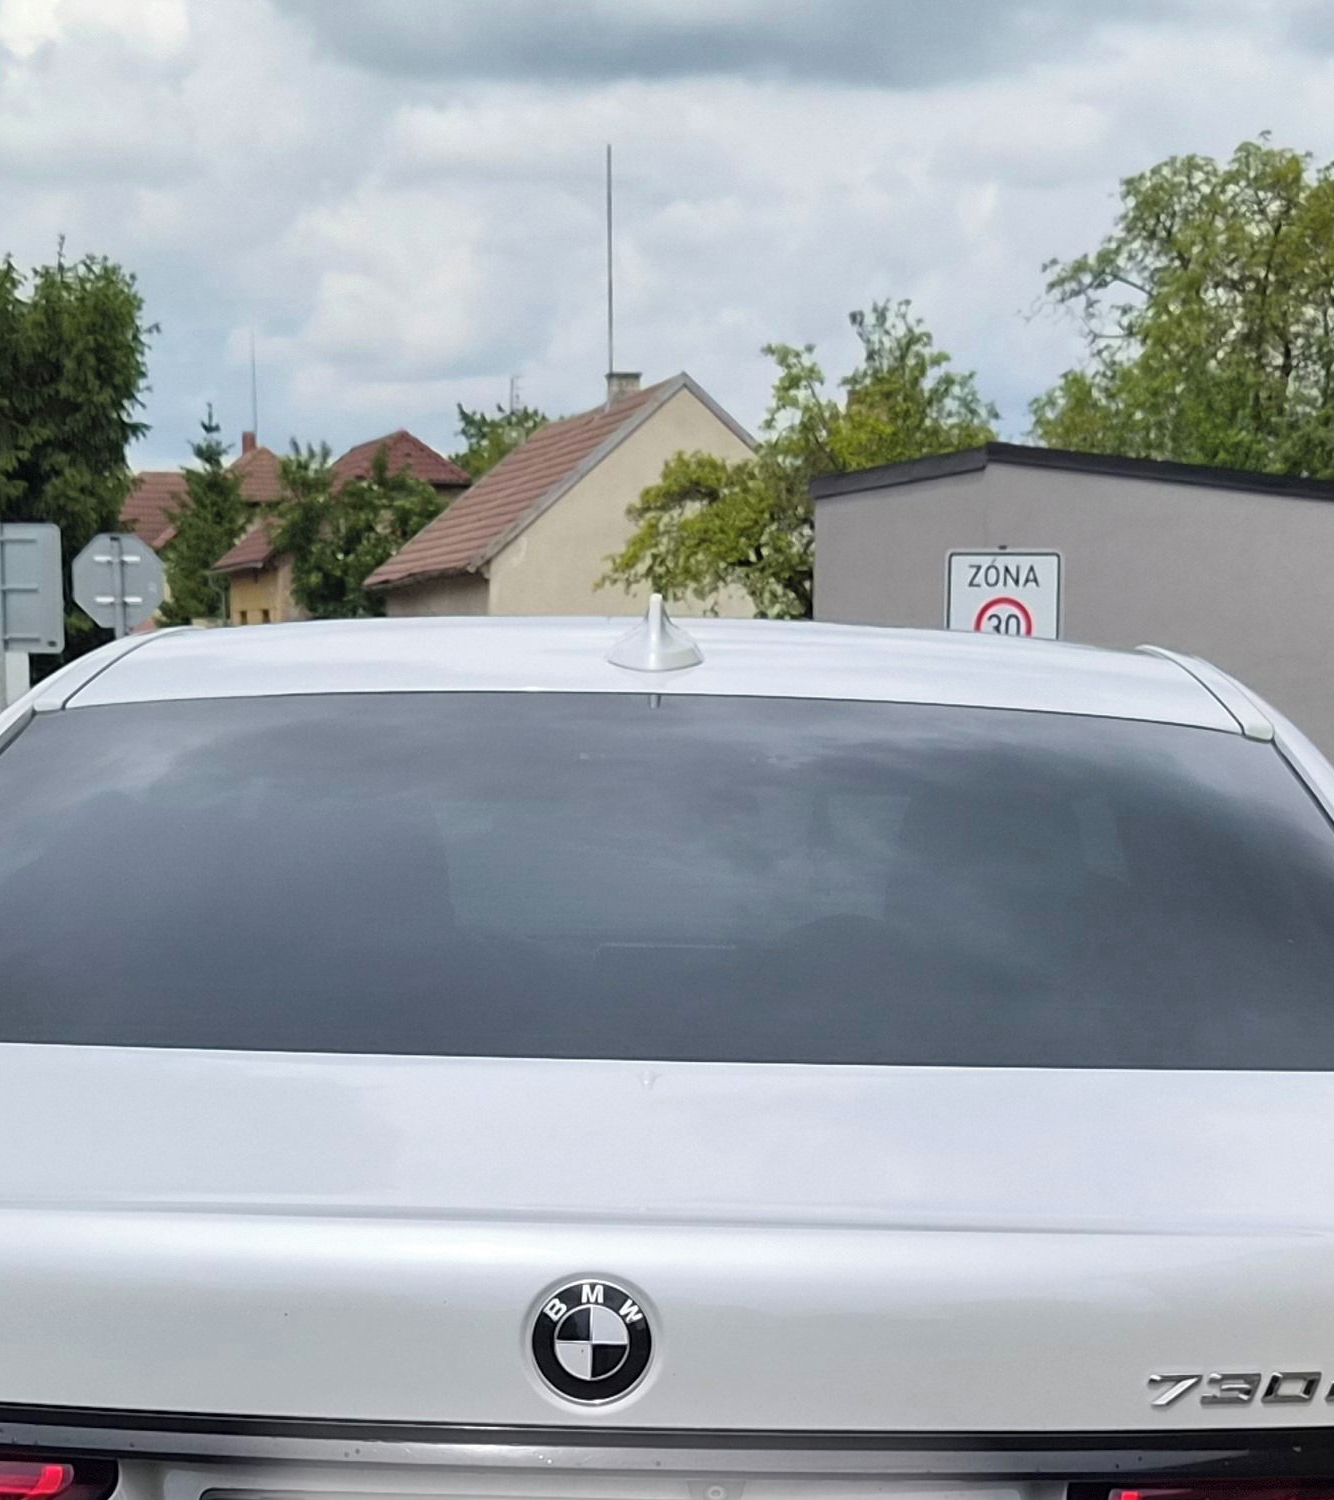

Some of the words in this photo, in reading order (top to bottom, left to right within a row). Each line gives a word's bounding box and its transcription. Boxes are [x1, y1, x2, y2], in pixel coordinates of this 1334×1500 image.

[968, 558, 1040, 588] ZÓNA
[987, 613, 1021, 636] 30
[543, 1284, 643, 1324] BMW
